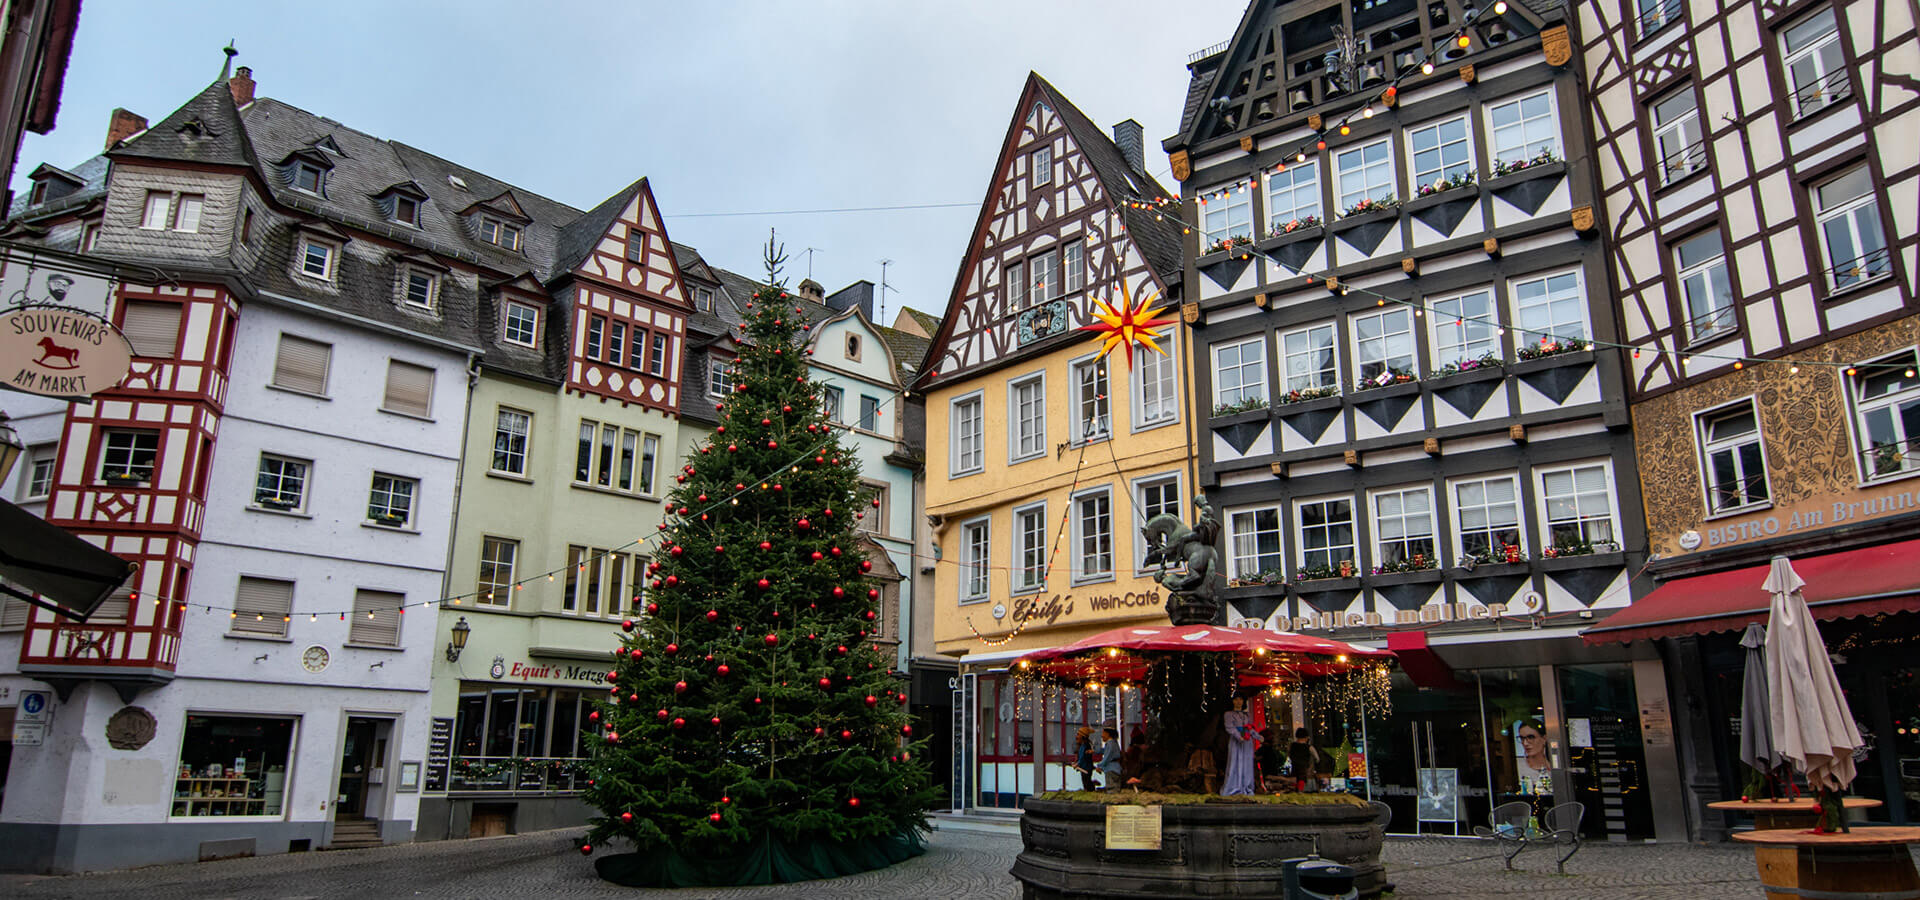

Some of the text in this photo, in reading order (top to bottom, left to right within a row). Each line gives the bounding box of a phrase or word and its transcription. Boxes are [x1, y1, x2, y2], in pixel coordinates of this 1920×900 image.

[10, 314, 108, 346] SOUVENIRS
[13, 368, 87, 393] AM MARKT
[1707, 516, 1780, 546] BISTRO
[1787, 510, 1824, 532] Am
[1090, 586, 1160, 612] Wein-Café
[1274, 602, 1508, 633] brillen müller
